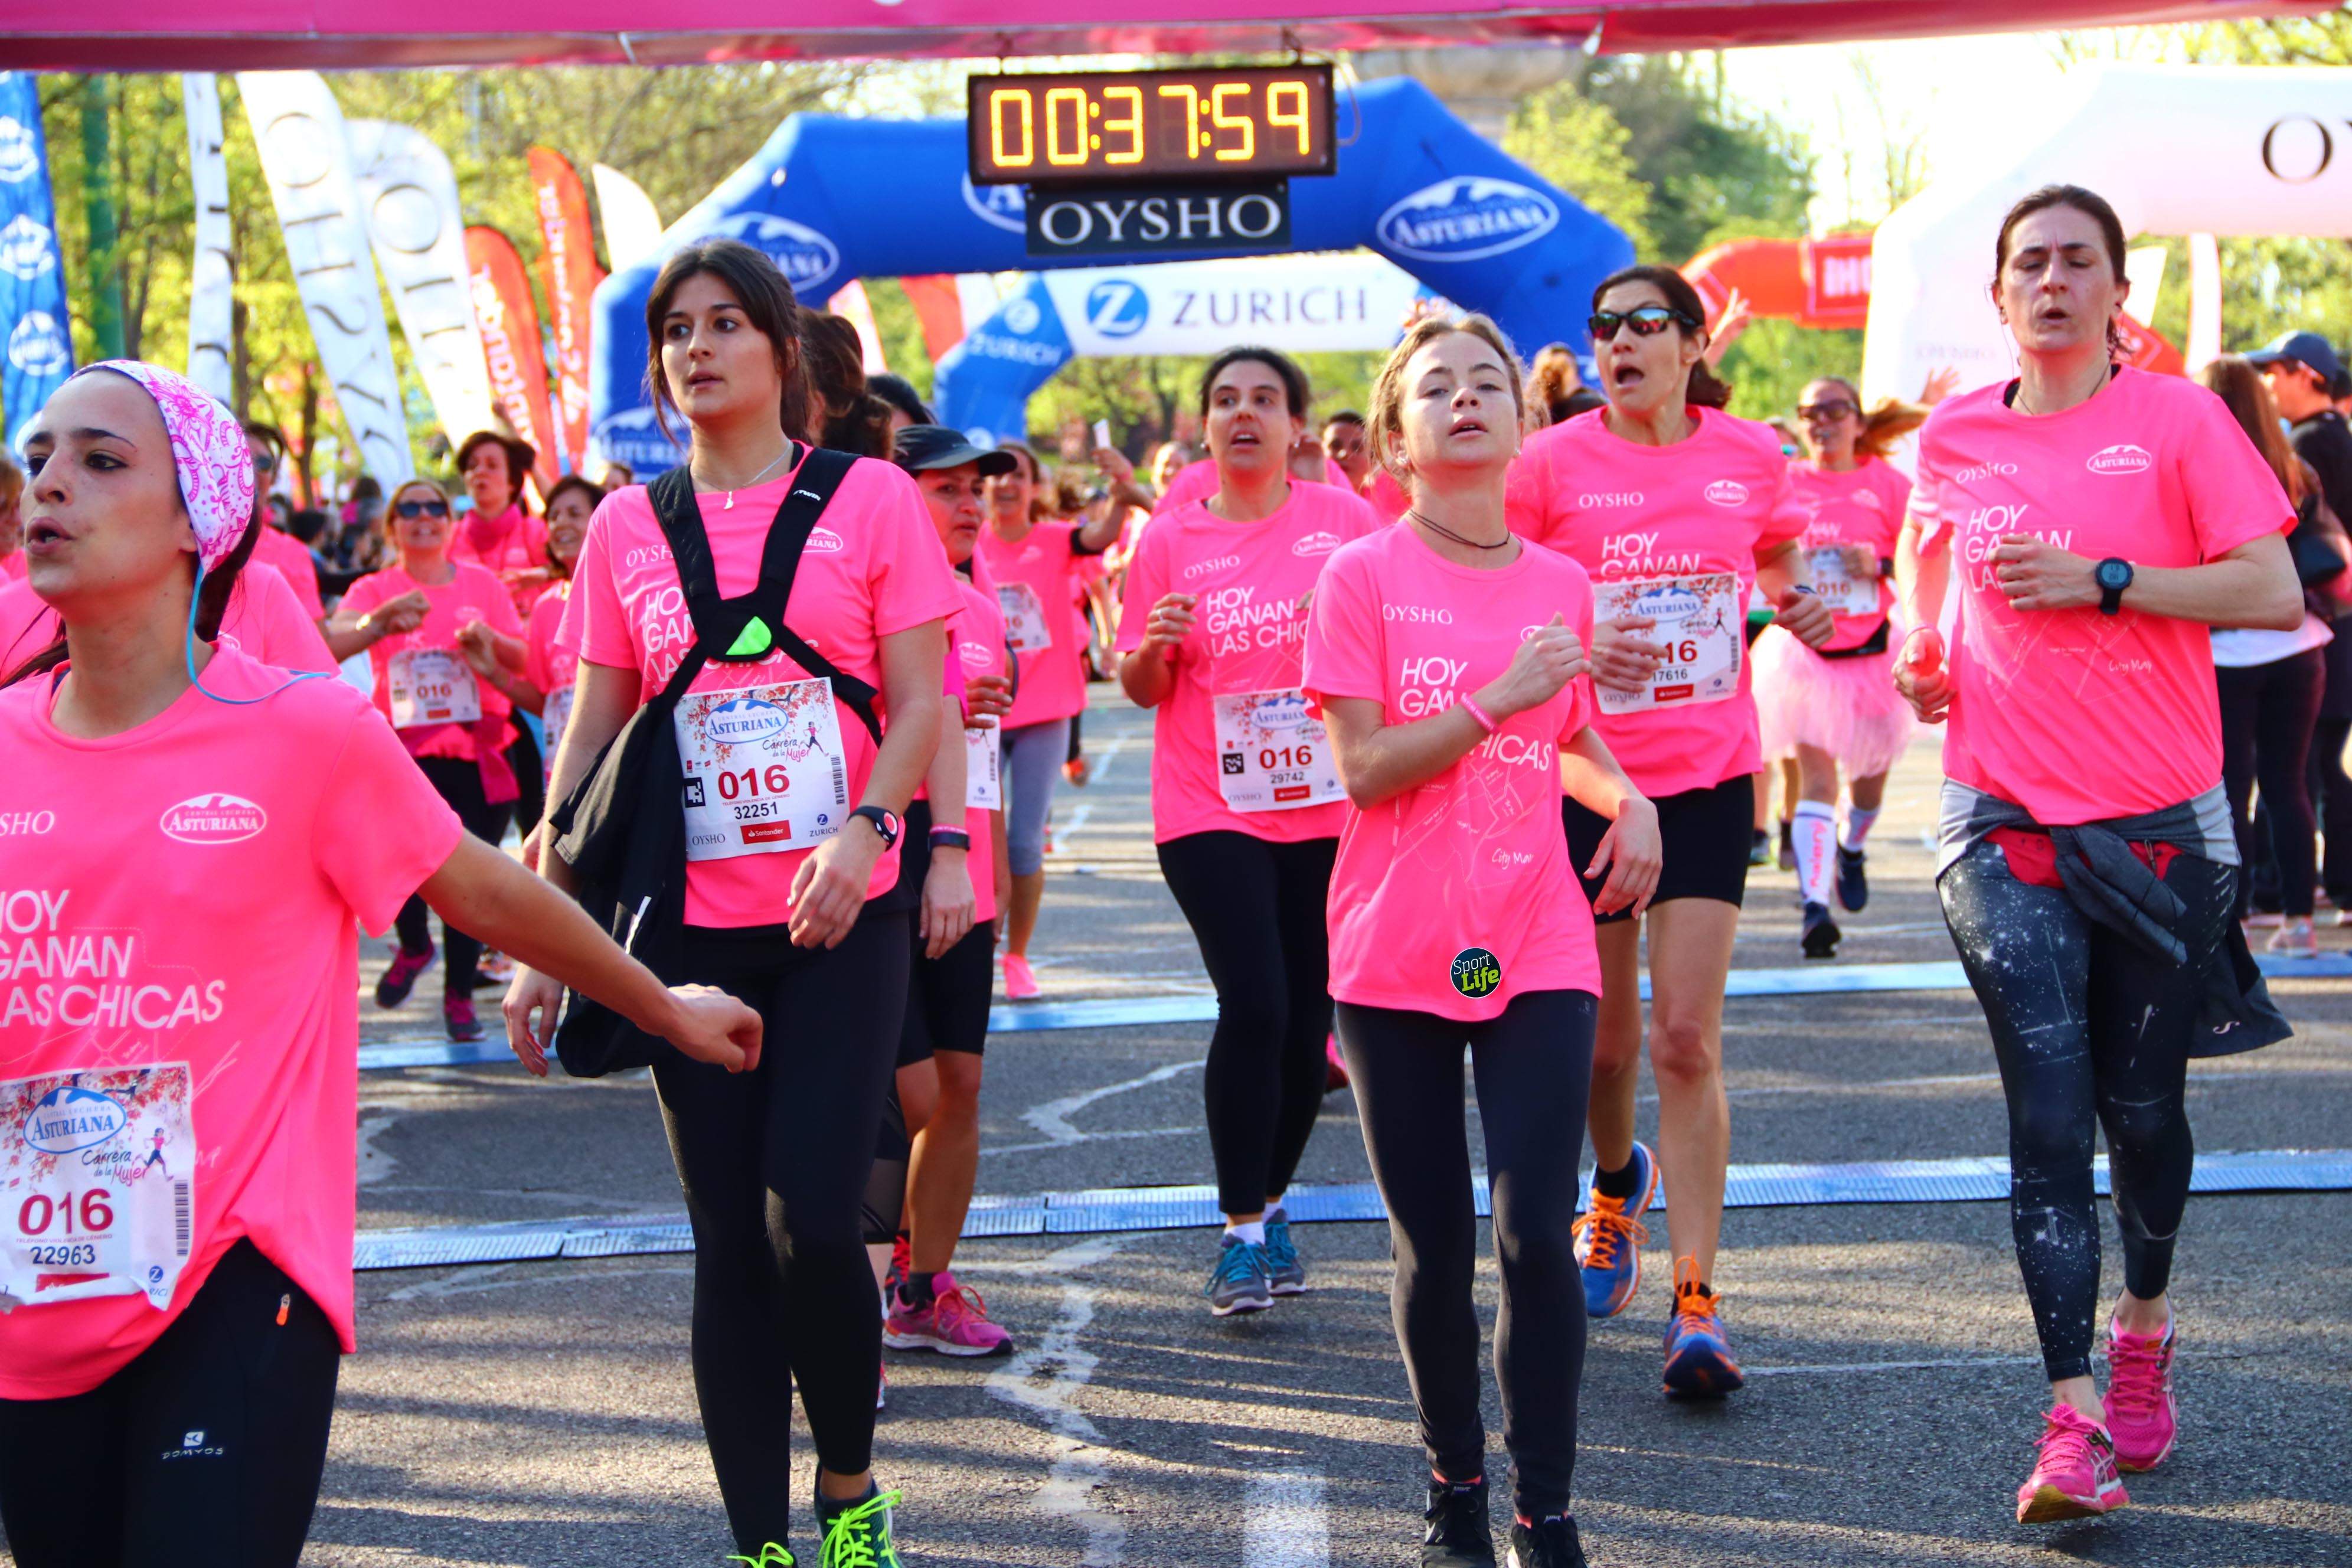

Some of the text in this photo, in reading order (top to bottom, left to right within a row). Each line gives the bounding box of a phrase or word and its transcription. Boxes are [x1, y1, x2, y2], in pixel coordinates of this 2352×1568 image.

[990, 81, 1309, 167] 00:37:59
[1040, 194, 1281, 245] OYSHO
[1393, 204, 1542, 246] ASTURIANA
[1172, 287, 1367, 325] ZURICH
[967, 332, 1062, 365] ZURICH
[1956, 460, 2018, 484] OYSHO
[2093, 457, 2148, 469] ASTURIANA
[1579, 491, 1644, 509] OYSHO
[1966, 504, 2028, 535] HOY
[626, 544, 674, 567] OYSH
[806, 538, 837, 549] RIANA
[1601, 532, 1660, 558] HOY
[1965, 530, 2072, 563] GAN
[1184, 554, 1240, 579] OYSHO
[1969, 564, 2004, 593] LA
[643, 586, 688, 622] HO
[1206, 586, 1255, 614] HOY
[1636, 602, 1698, 616] ASTURIANA
[1206, 599, 1294, 634] GANAN
[1382, 603, 1453, 625] OYSHO
[645, 613, 695, 653] GAN
[1211, 619, 1309, 658] LAS CHIC
[1664, 639, 1698, 664] 16
[1400, 656, 1469, 687] HOY
[416, 682, 453, 700] 016
[1399, 688, 1455, 717] GAN
[708, 716, 783, 736] ASTURIANA
[1256, 711, 1305, 723] ASTURIAN
[762, 739, 798, 750] Carrera
[785, 748, 811, 762] Mujer
[1259, 744, 1312, 770] 016
[1469, 732, 1552, 772] HICAS
[717, 764, 790, 800] 016
[1270, 771, 1305, 784] 29742
[166, 812, 259, 832] ASTURIANA
[733, 801, 779, 819] 32251
[692, 833, 726, 846] OYSHO
[754, 828, 784, 837] Santander
[809, 826, 839, 837] ZURICH
[0, 889, 70, 934] OY
[1453, 953, 1491, 975] Sport
[1461, 966, 1500, 992] Life
[0, 979, 226, 1028] AS CHICAS
[31, 1114, 115, 1142] ASTURIANA
[81, 1149, 132, 1165] Carrera
[93, 1164, 148, 1187] de la Mujer
[18, 1188, 114, 1236] 016
[30, 1244, 96, 1266] 22963
[162, 1448, 224, 1460] DOMYOS
